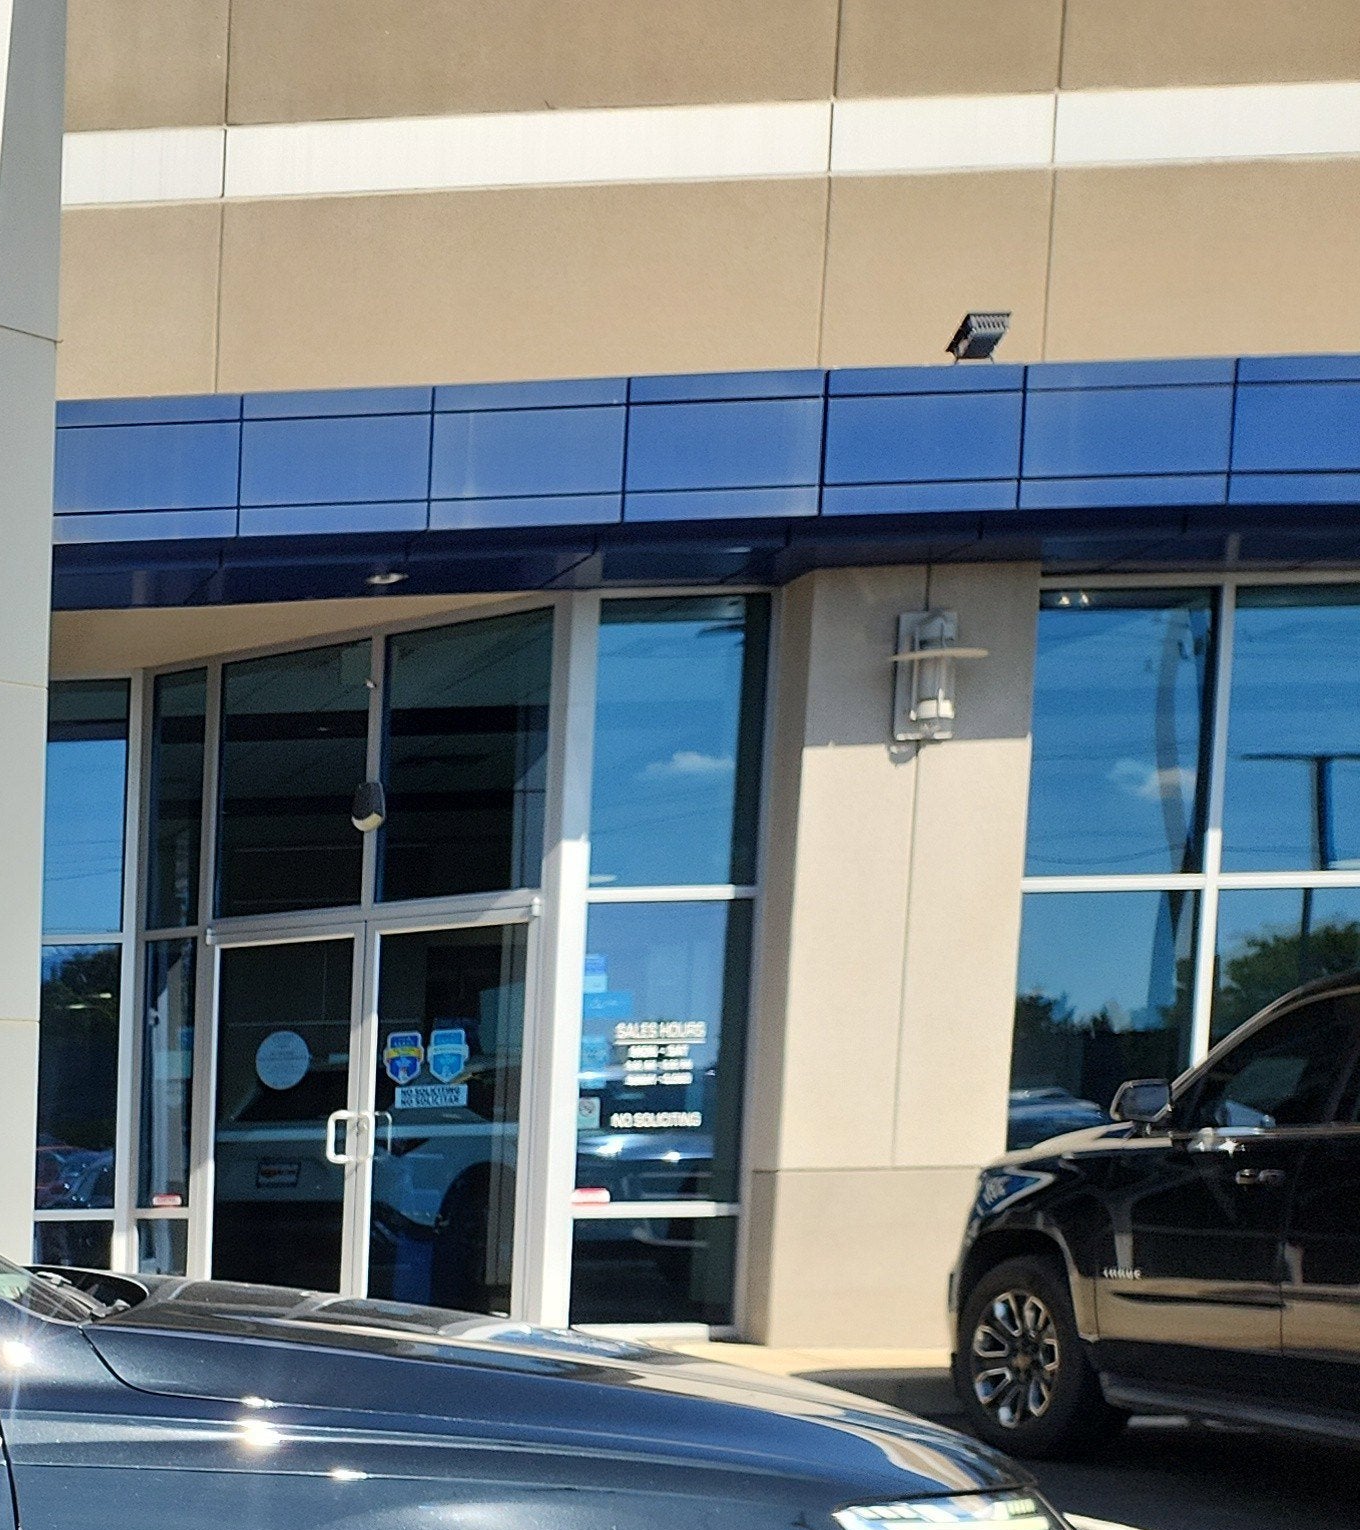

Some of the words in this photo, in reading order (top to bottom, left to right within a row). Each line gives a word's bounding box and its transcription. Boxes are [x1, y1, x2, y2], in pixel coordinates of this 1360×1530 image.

[614, 1021, 658, 1039] SALES
[660, 1021, 707, 1038] HOURS
[610, 1112, 633, 1128] NO
[633, 1111, 702, 1128] SOLICITING
